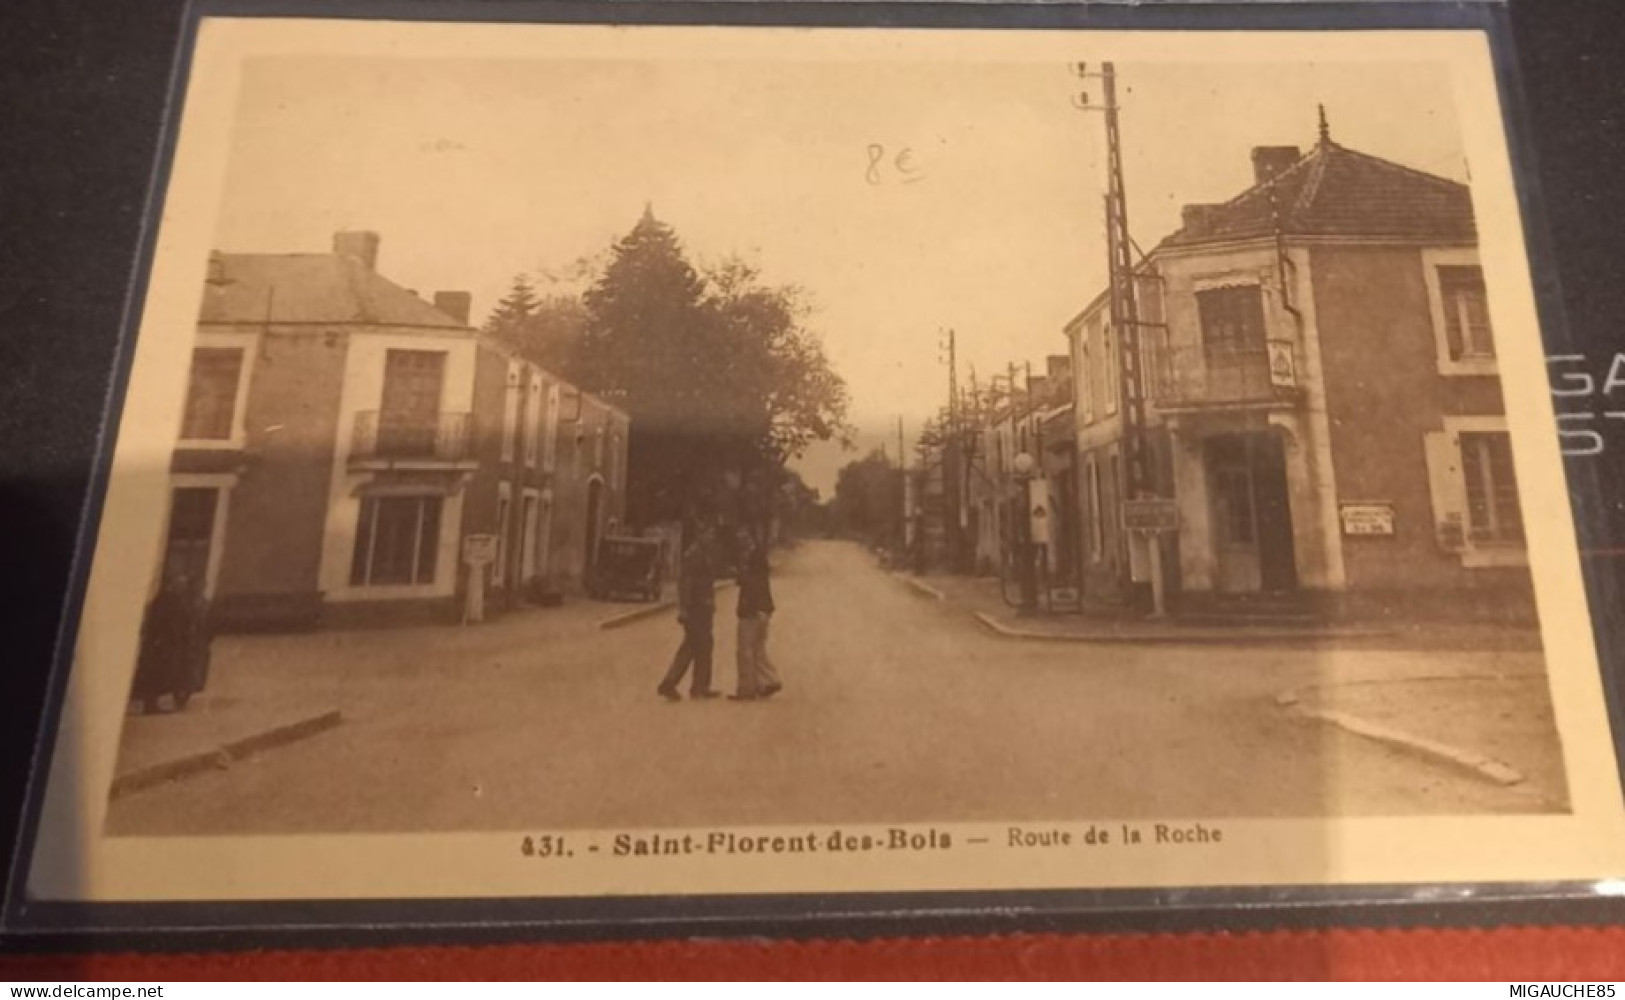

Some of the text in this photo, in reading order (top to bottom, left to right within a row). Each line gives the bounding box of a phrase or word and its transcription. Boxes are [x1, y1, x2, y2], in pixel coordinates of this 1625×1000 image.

[864, 143, 884, 186] 8
[521, 835, 574, 857] 431.
[1007, 826, 1072, 848] Route
[1084, 824, 1110, 846] de
[1122, 823, 1142, 844] la
[1154, 822, 1223, 844] Roche
